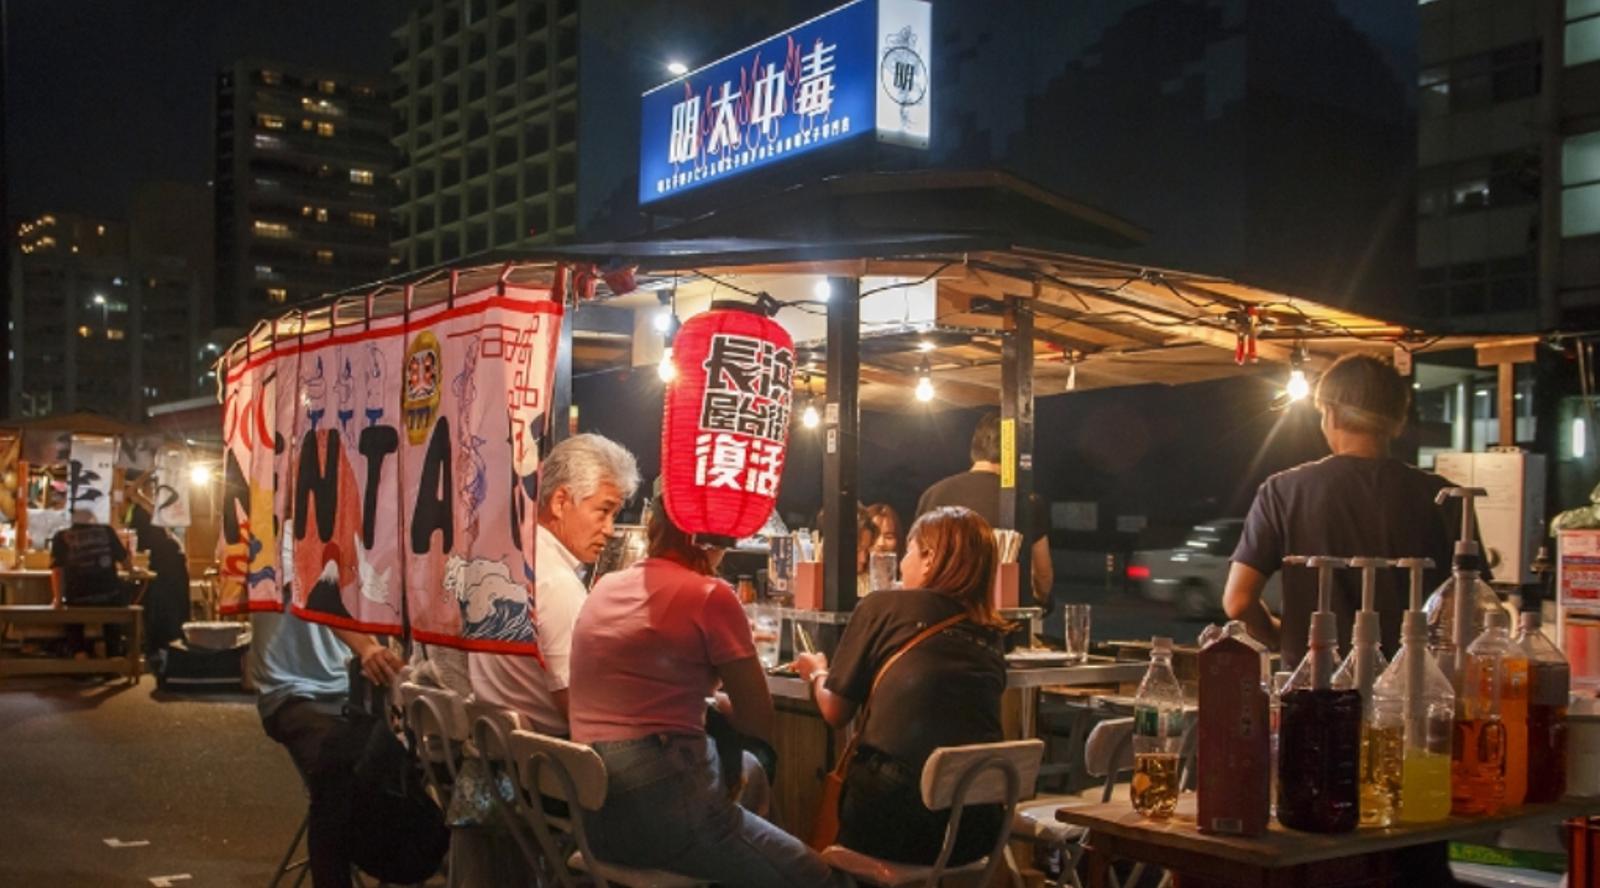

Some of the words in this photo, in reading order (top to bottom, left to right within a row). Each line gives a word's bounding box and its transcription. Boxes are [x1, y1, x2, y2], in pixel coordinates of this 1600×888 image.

[669, 42, 837, 164] 明太中毒
[893, 61, 915, 92] 明
[702, 334, 793, 402] 長浜
[699, 392, 788, 446] 屋台街
[695, 433, 784, 498] 復活
